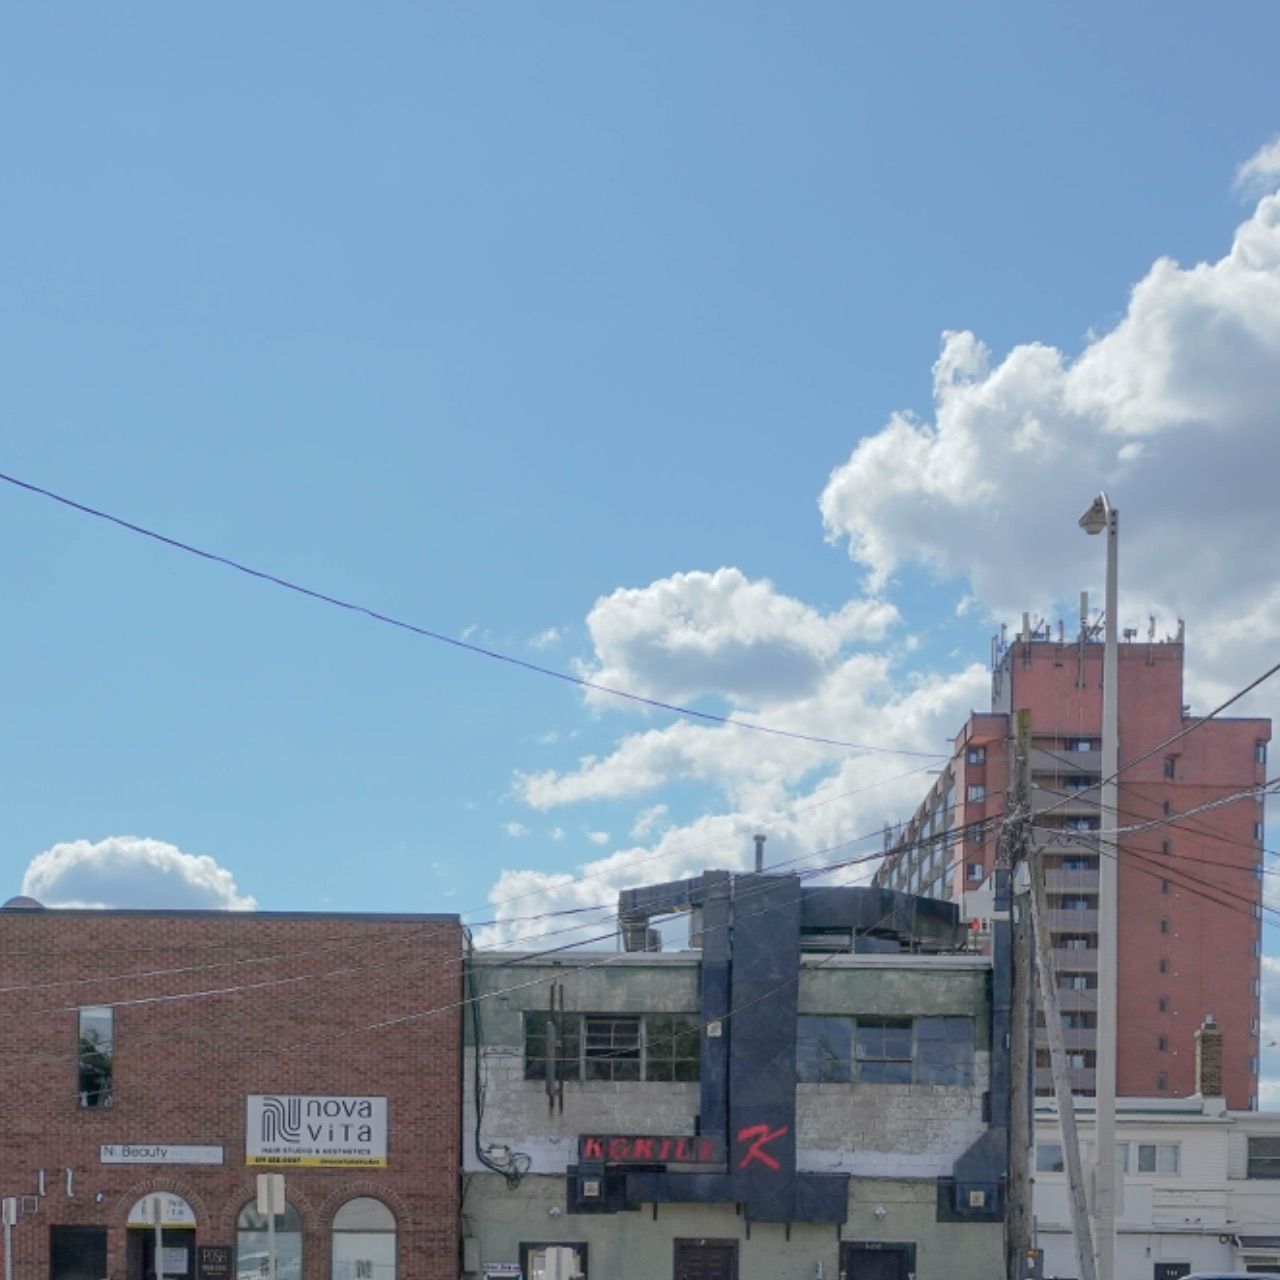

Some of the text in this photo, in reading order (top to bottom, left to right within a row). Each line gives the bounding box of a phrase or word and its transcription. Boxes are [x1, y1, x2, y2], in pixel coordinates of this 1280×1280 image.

[307, 1099, 373, 1118] nova
[122, 1146, 168, 1158] Beauty
[283, 1147, 312, 1155] STUDIO
[737, 1123, 789, 1170] K
